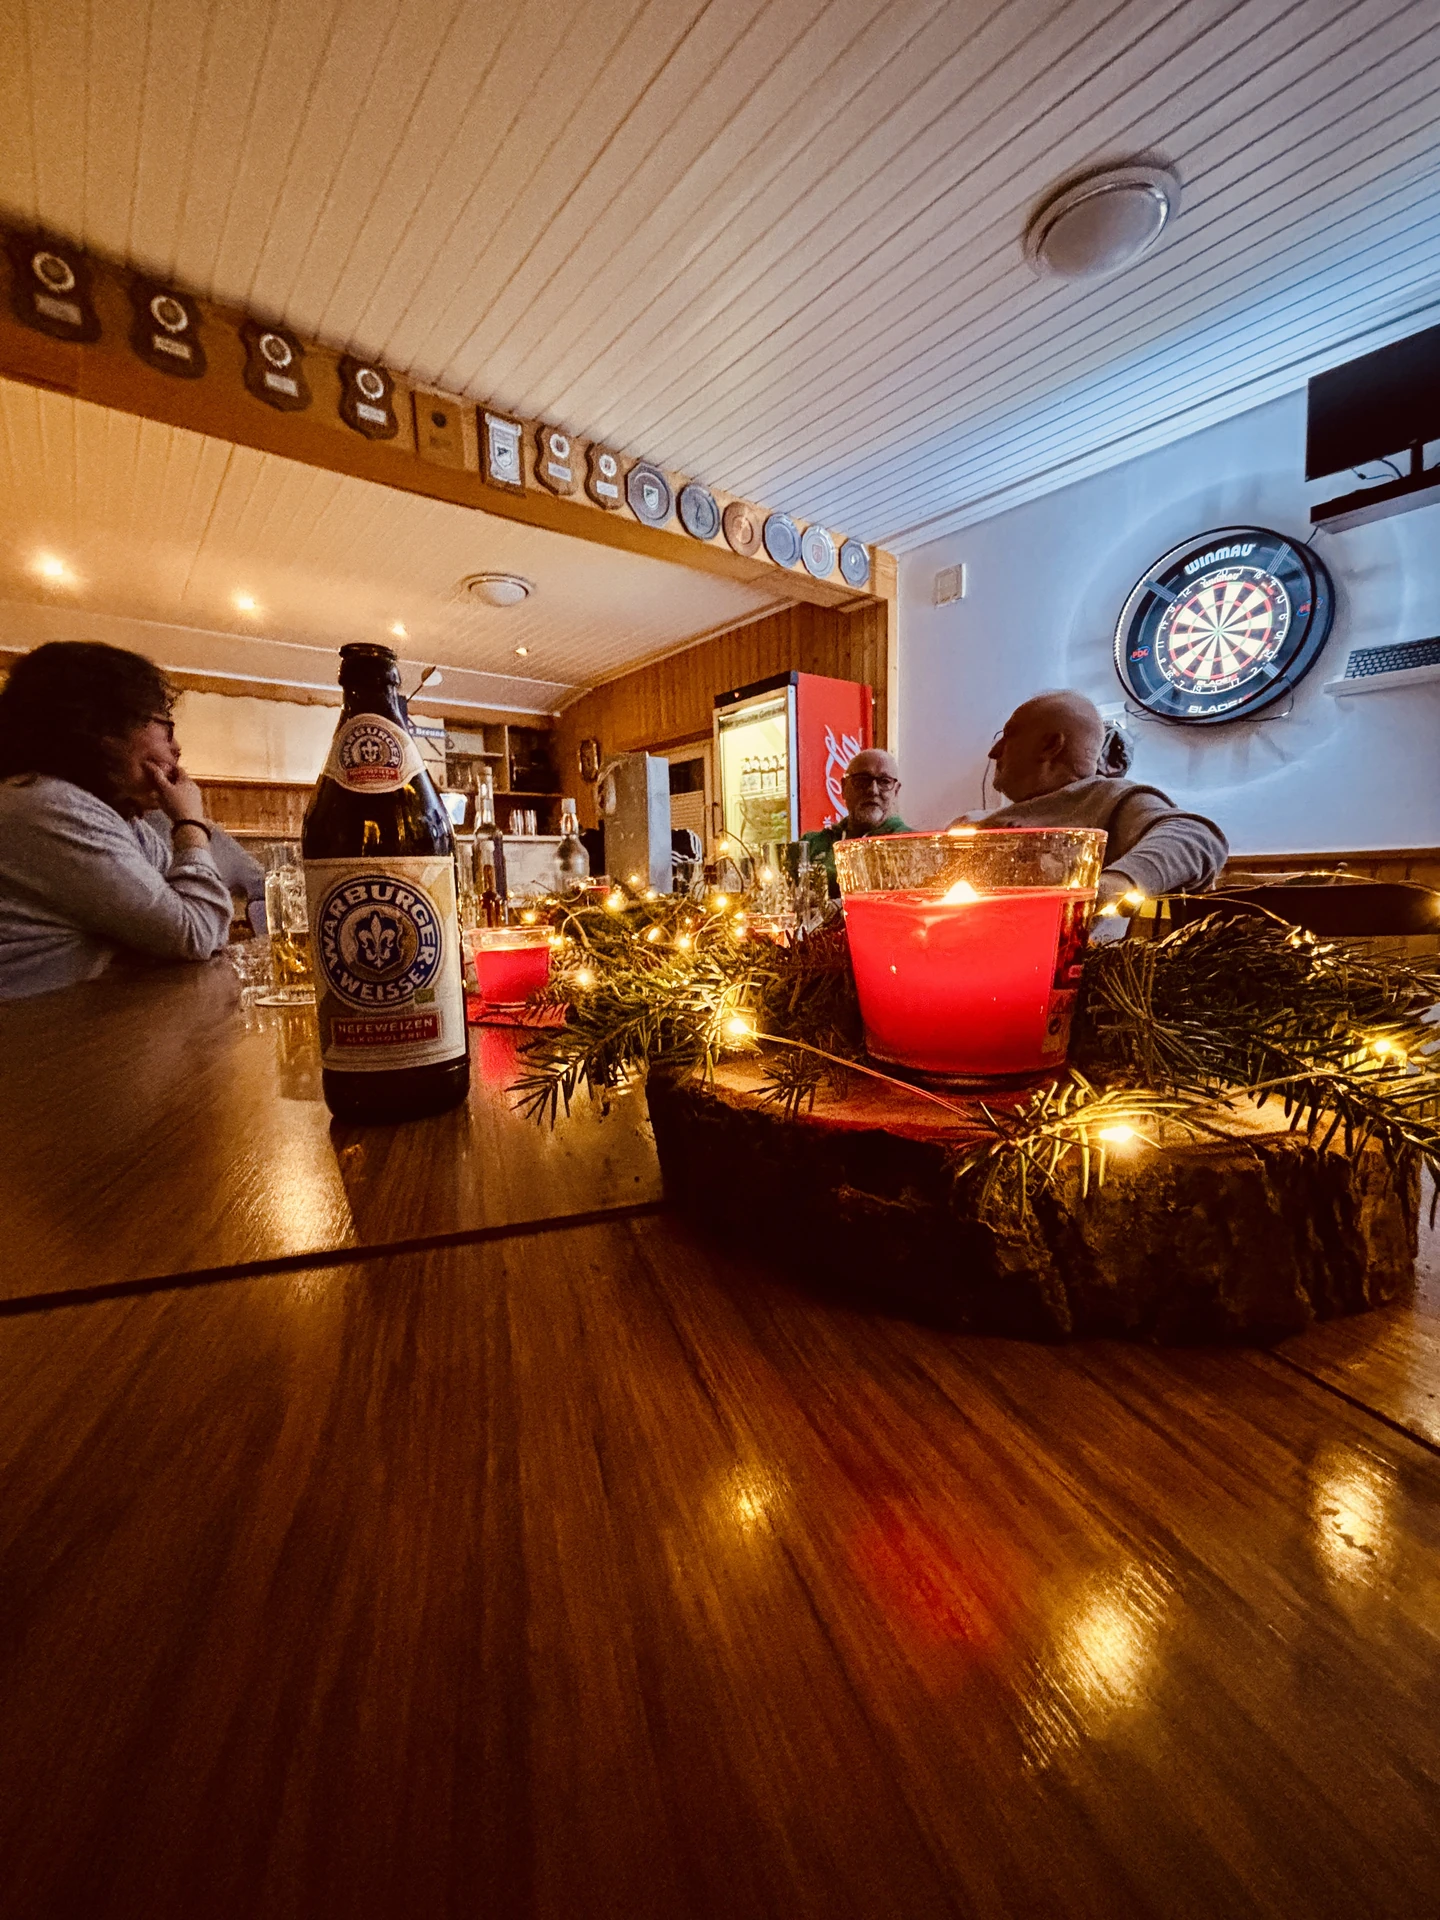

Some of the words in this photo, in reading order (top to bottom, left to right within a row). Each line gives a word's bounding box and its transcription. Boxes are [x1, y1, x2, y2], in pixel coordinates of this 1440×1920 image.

[1132, 648, 1149, 658] PDC
[323, 884, 437, 971] WARBURGER
[339, 968, 426, 1000] WEISSE
[338, 1017, 433, 1034] HEFEWEIZEN
